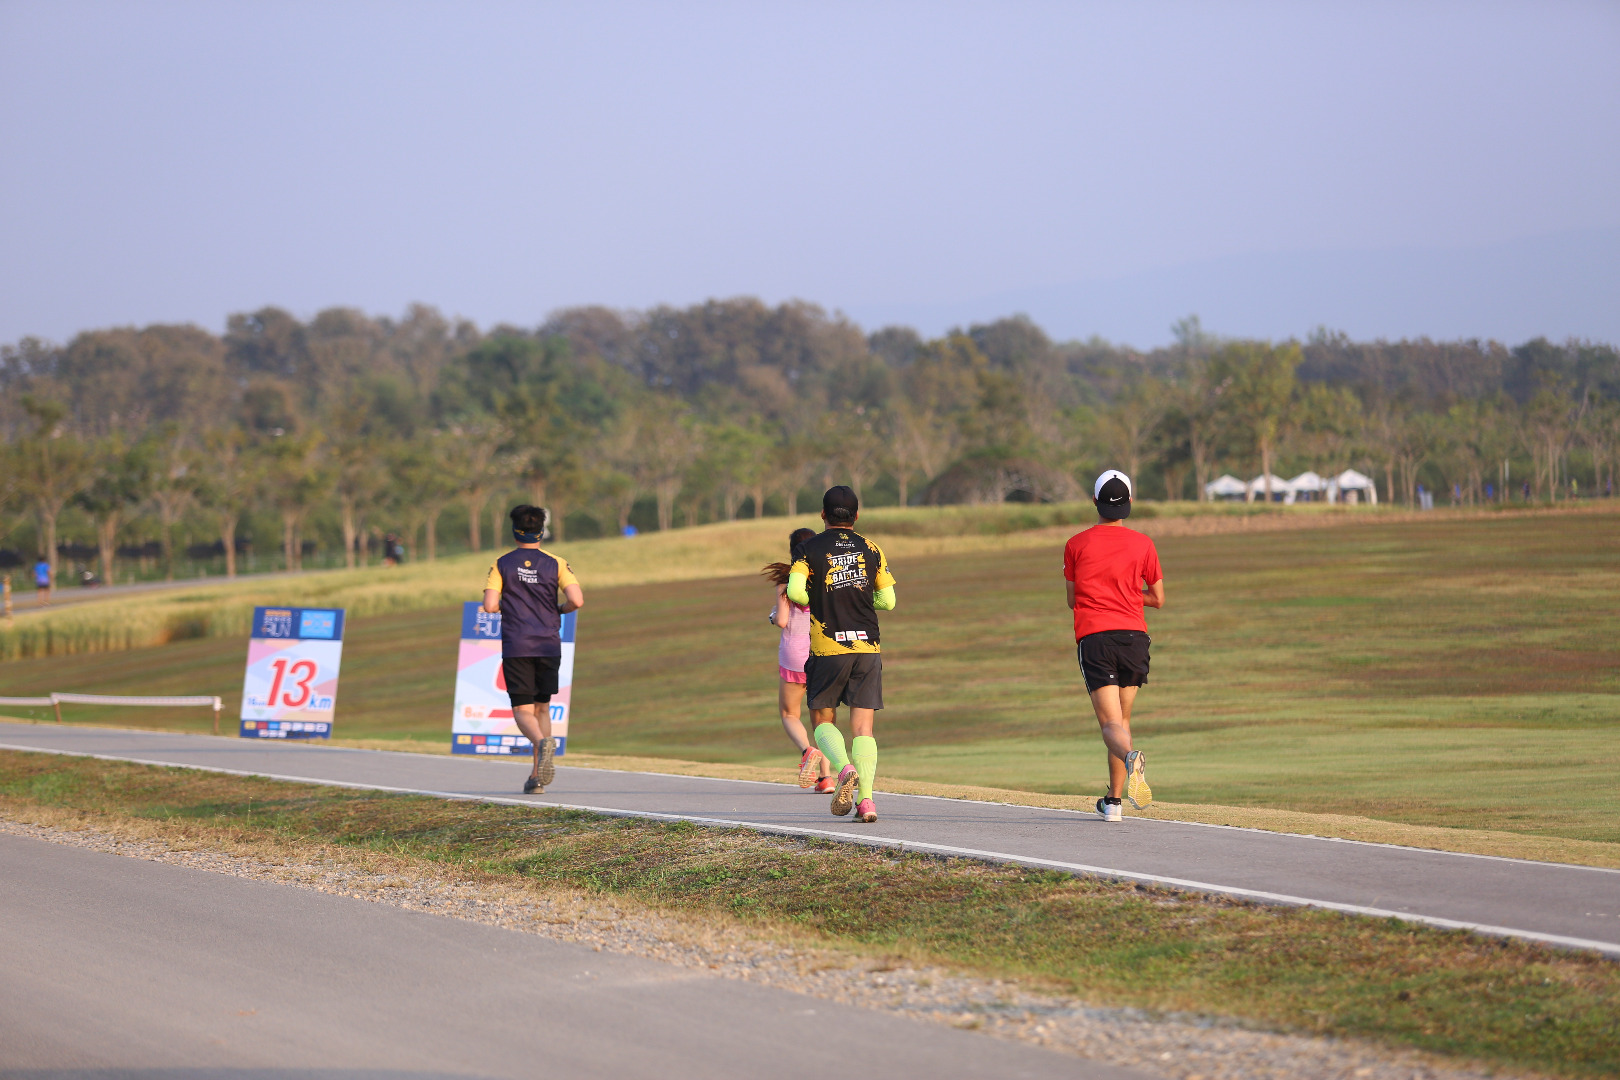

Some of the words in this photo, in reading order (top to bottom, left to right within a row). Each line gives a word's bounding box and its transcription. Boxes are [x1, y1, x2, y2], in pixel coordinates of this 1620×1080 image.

[832, 554, 858, 568] PRIDE
[833, 568, 864, 583] BATTLE
[474, 619, 503, 637] RU
[267, 659, 317, 707] 13
[308, 694, 332, 709] km
